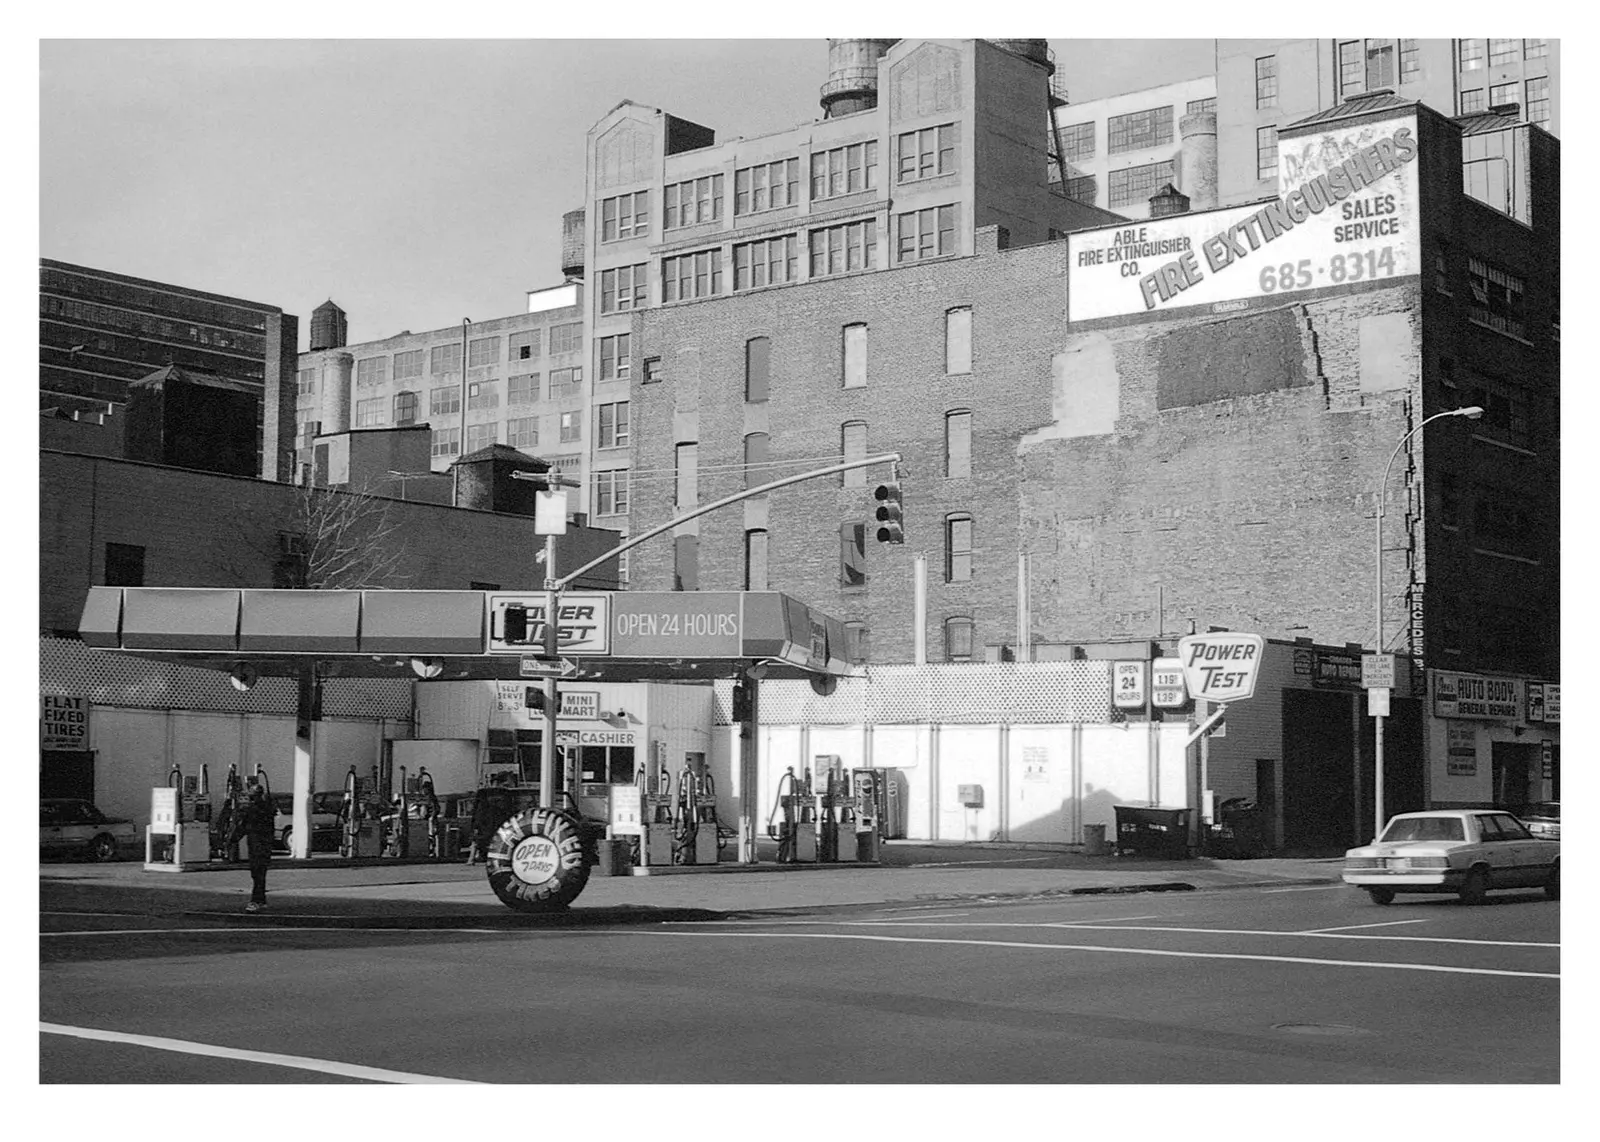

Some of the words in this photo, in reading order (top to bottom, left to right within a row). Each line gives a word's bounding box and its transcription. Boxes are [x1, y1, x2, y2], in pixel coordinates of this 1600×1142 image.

[1342, 195, 1396, 221] SALES
[1139, 250, 1204, 310] FIRE
[1202, 127, 1418, 273] EXTINGUISHERS
[1114, 228, 1147, 246] ABLE
[1334, 218, 1399, 243] SERVICE
[1078, 249, 1103, 267] FIRE
[1107, 237, 1191, 263] EXTINGUISHER
[1120, 261, 1141, 278] CO.
[617, 613, 658, 636] OPEN
[660, 614, 680, 636] 24
[684, 613, 738, 636] HOURS
[1410, 584, 1425, 656] MERCEDES
[1188, 643, 1256, 667] POWER
[523, 660, 541, 670] ONE
[1119, 665, 1139, 674] OPEN
[1122, 676, 1137, 690] 24
[1200, 666, 1249, 693] TEST
[497, 692, 524, 700] SERVE
[1116, 691, 1141, 701] HOURS
[1457, 678, 1484, 701] AUTO
[44, 695, 83, 709] FLAT
[566, 695, 593, 706] MINI
[44, 709, 84, 723] FIXED
[562, 706, 595, 716] MART
[1458, 701, 1487, 716] GENERAL
[1488, 704, 1517, 718] REPAIRS
[44, 722, 85, 737] TIRES
[581, 732, 634, 744] CASHIER
[532, 809, 583, 871] FIXED
[515, 843, 552, 861] OPEN
[521, 861, 529, 872] 7
[529, 861, 554, 873] DAYS
